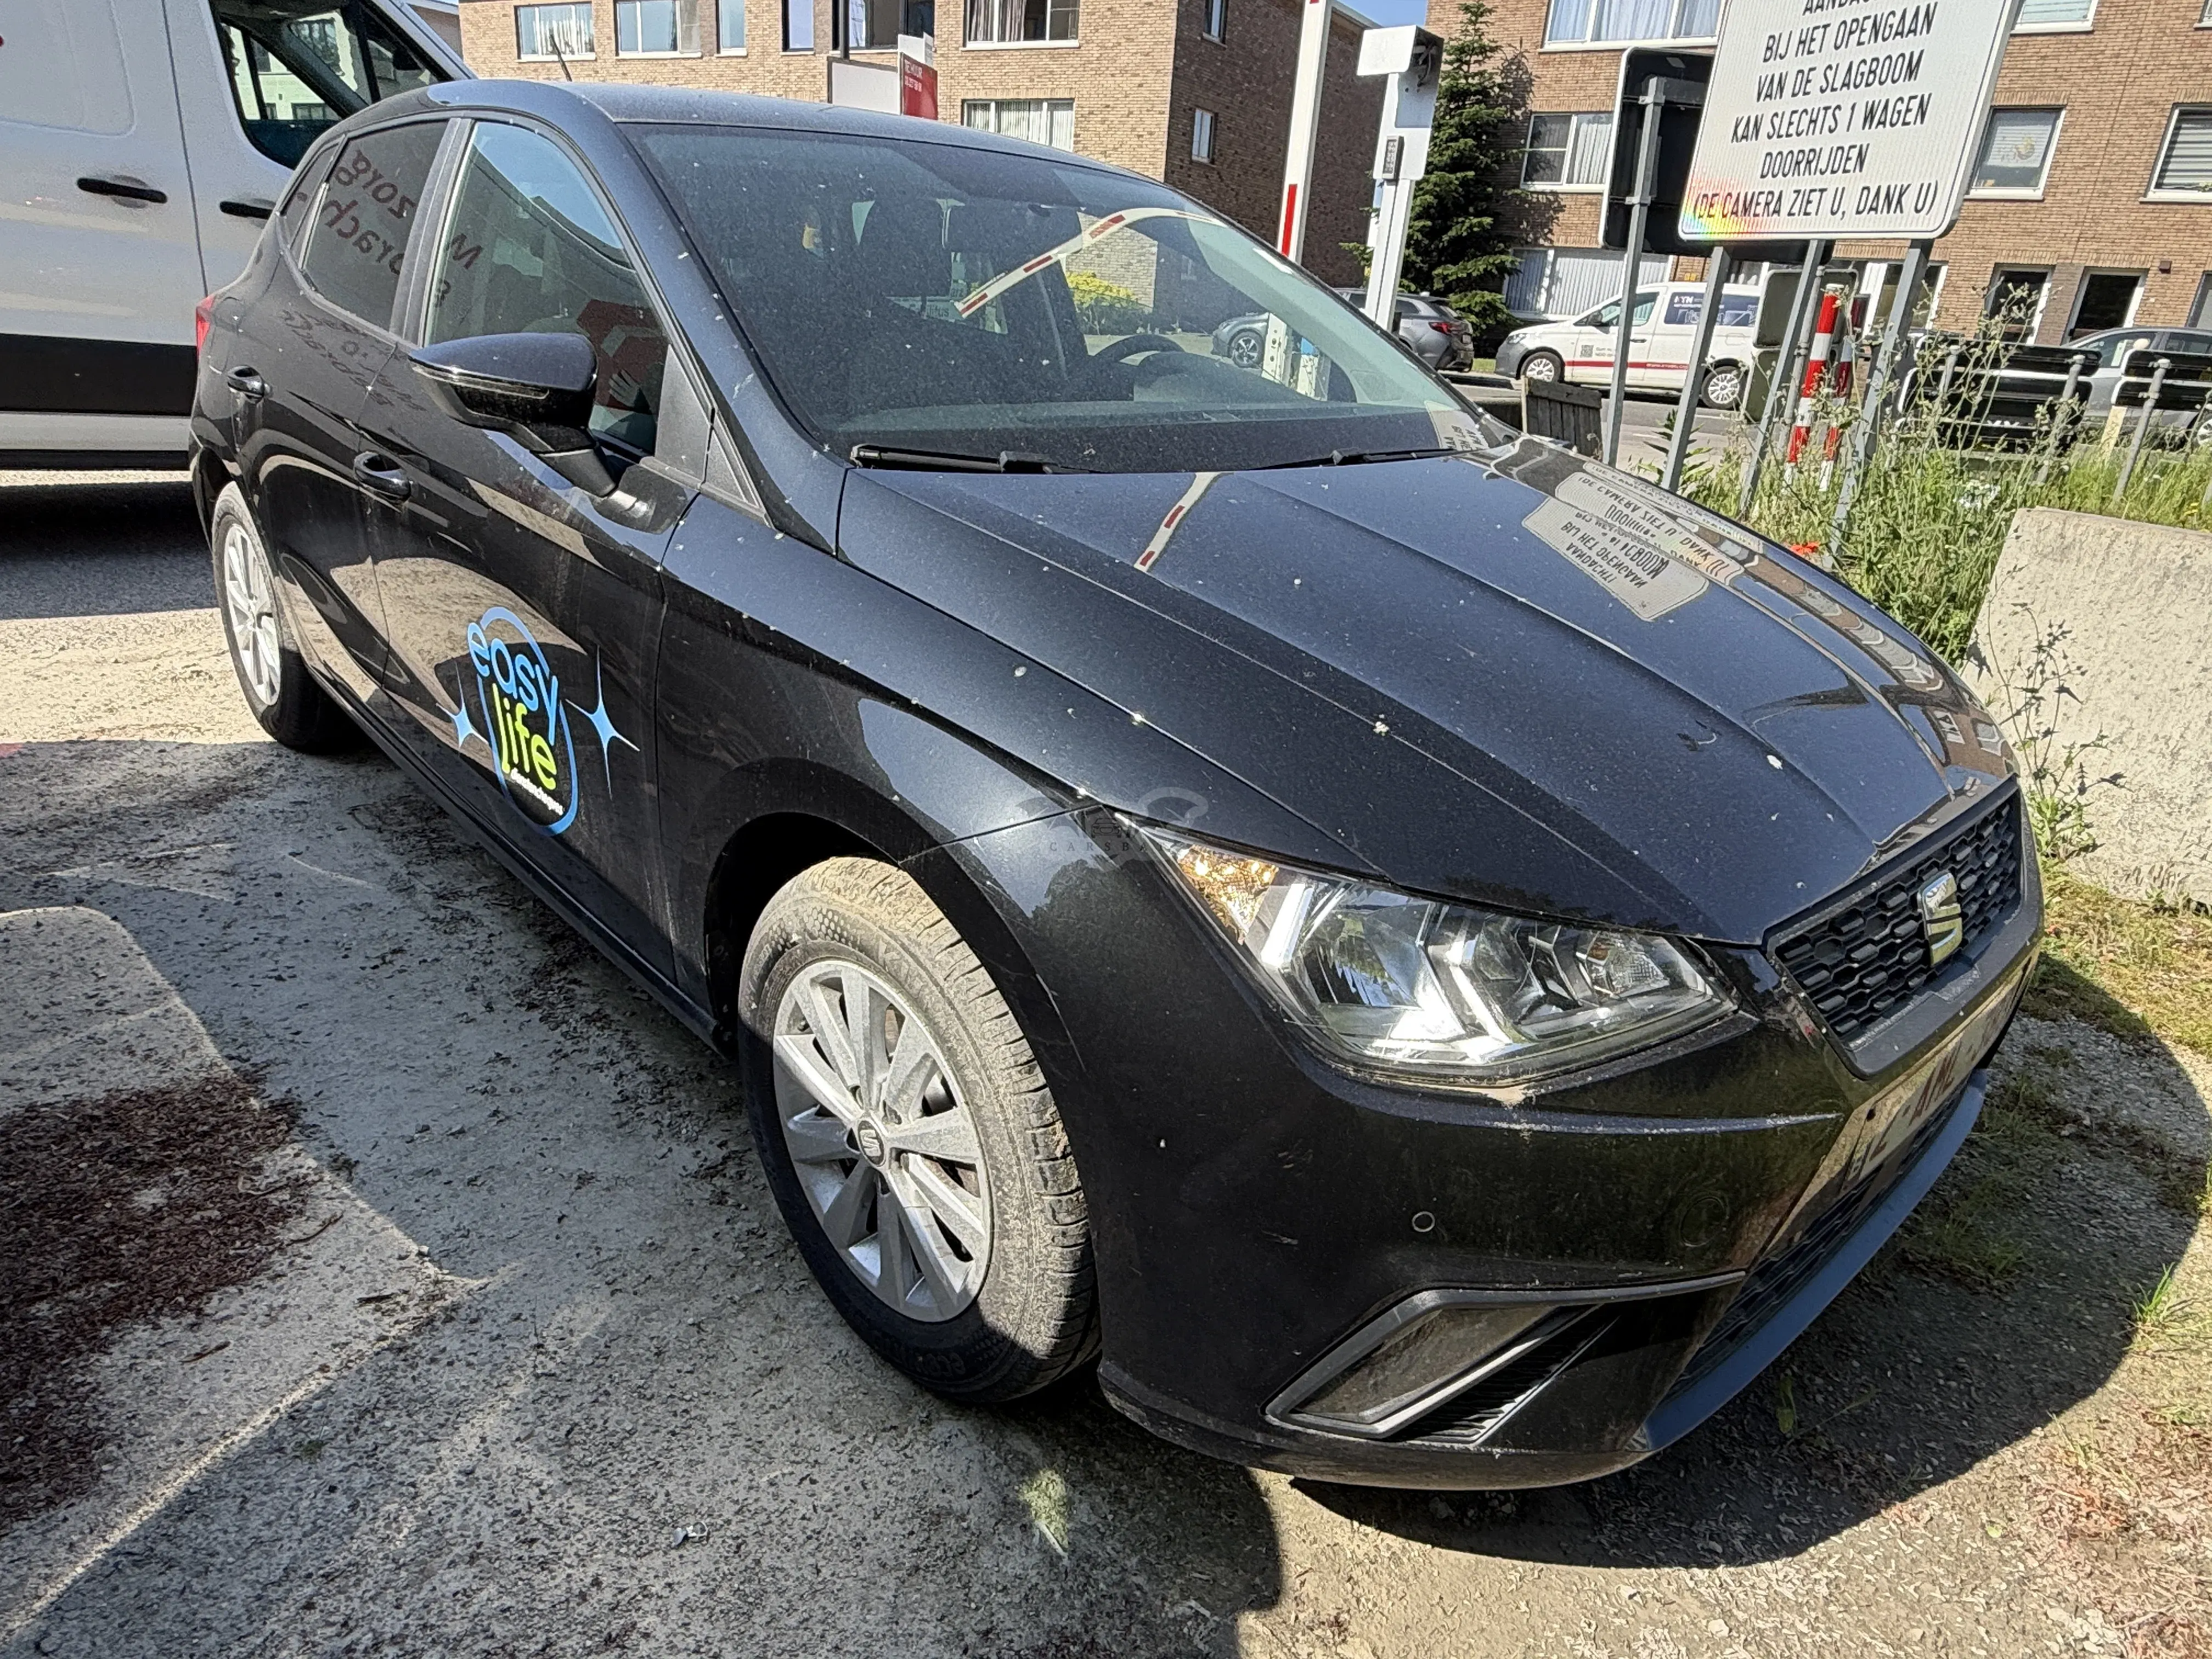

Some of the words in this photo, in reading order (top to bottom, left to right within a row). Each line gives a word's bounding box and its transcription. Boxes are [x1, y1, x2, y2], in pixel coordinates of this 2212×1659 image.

[1762, 30, 1793, 63] BIJ
[1795, 22, 1831, 58] HET
[1833, 1, 1938, 52] OPENGAAN
[1756, 70, 1788, 103] VAN
[1791, 66, 1817, 98] DE
[1819, 48, 1925, 94] SLAGBOOM
[1731, 113, 1764, 144] KAN
[1767, 104, 1842, 140] SLECHTS
[1846, 102, 1857, 133] 1
[1861, 92, 1932, 131] WAGEN
[1759, 143, 1870, 179] DOORRIJDEN
[1692, 193, 1721, 220] (DE
[1722, 190, 1784, 219] CAMERA
[1786, 187, 1828, 217] ZIET
[1830, 187, 1846, 221] U,
[1855, 183, 1912, 215] DANK
[1914, 180, 1938, 216] U)
[467, 622, 558, 746] easy
[492, 682, 557, 790] life
